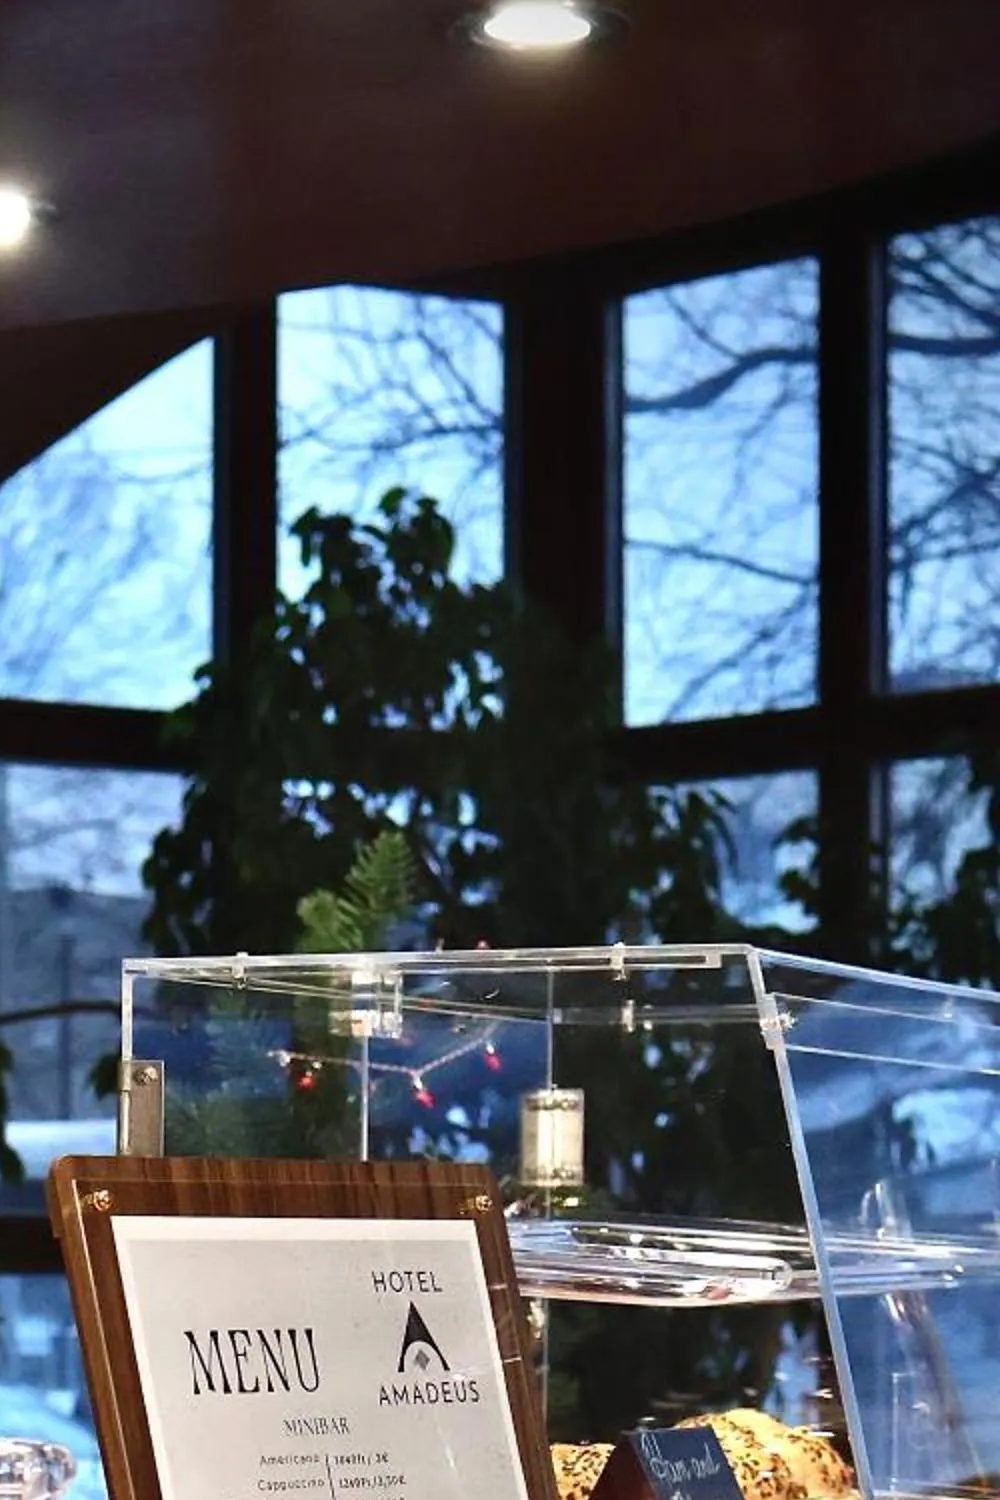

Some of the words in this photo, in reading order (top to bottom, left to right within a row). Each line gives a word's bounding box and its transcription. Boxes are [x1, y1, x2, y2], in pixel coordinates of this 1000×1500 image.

[371, 1270, 444, 1294] HOTEL
[183, 1327, 320, 1395] MENU
[378, 1380, 481, 1406] AMADEUS
[282, 1416, 350, 1437] MINIBAR
[259, 1454, 321, 1468] Americano
